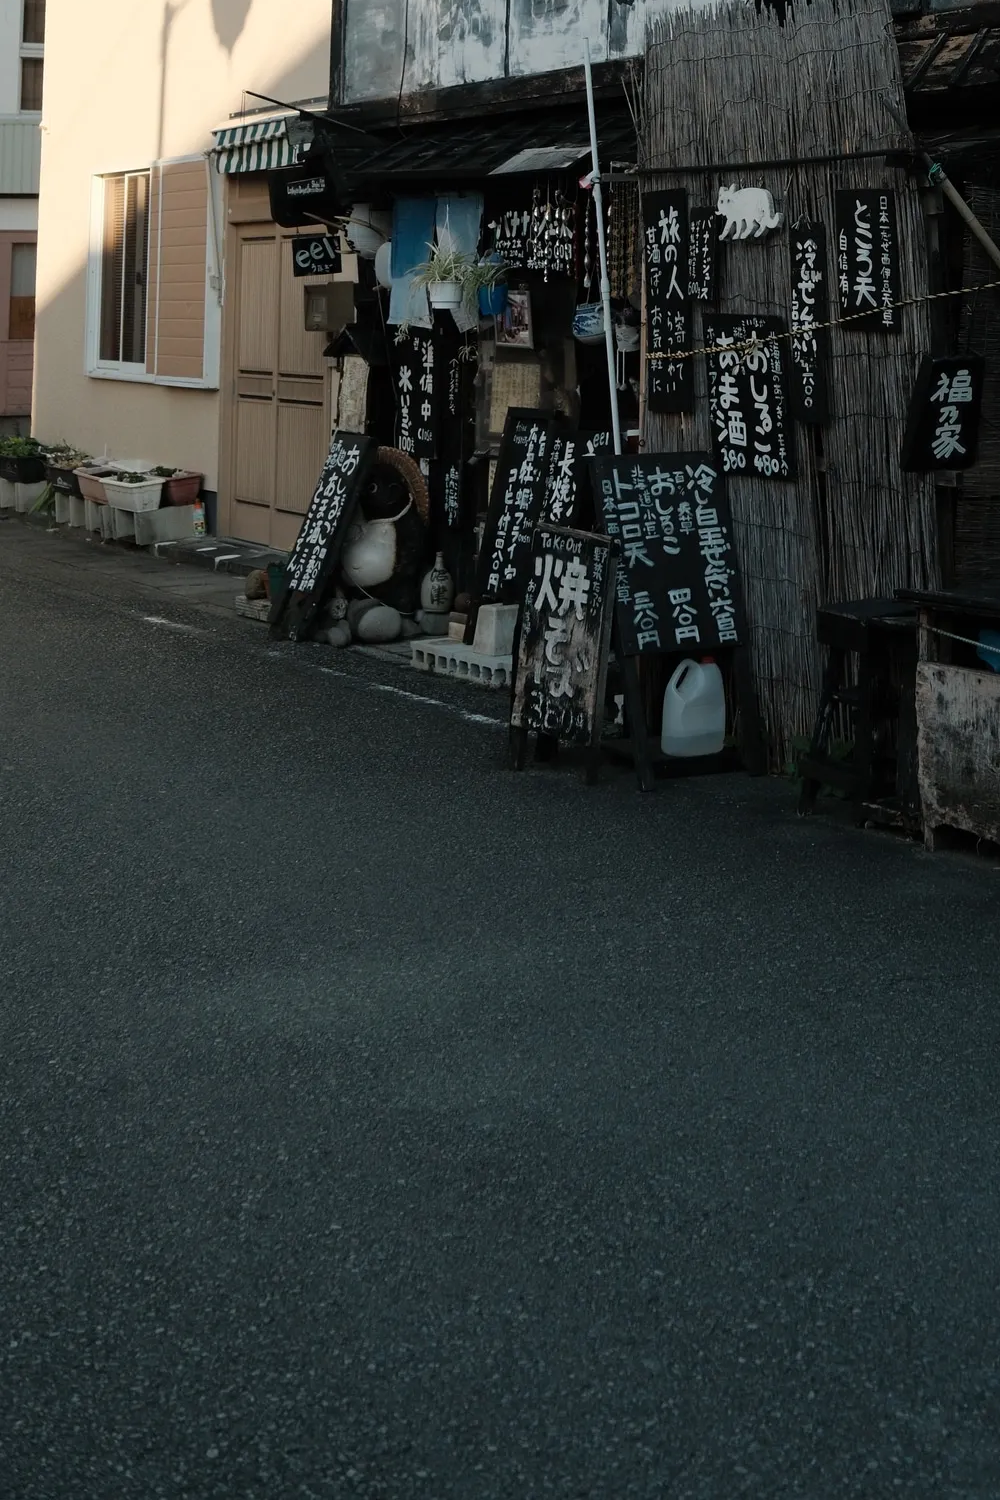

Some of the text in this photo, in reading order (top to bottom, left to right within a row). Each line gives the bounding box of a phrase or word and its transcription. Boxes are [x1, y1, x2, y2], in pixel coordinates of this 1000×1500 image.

[658, 205, 684, 300] 旅の人
[853, 199, 877, 307] ところ天
[419, 339, 434, 422] 準備中
[930, 369, 973, 460] 福乃家
[720, 446, 747, 472] 380
[753, 453, 780, 477] 480
[612, 468, 655, 569] トコロ天
[647, 466, 681, 555] おしるこ
[533, 553, 591, 699] 焼そば
